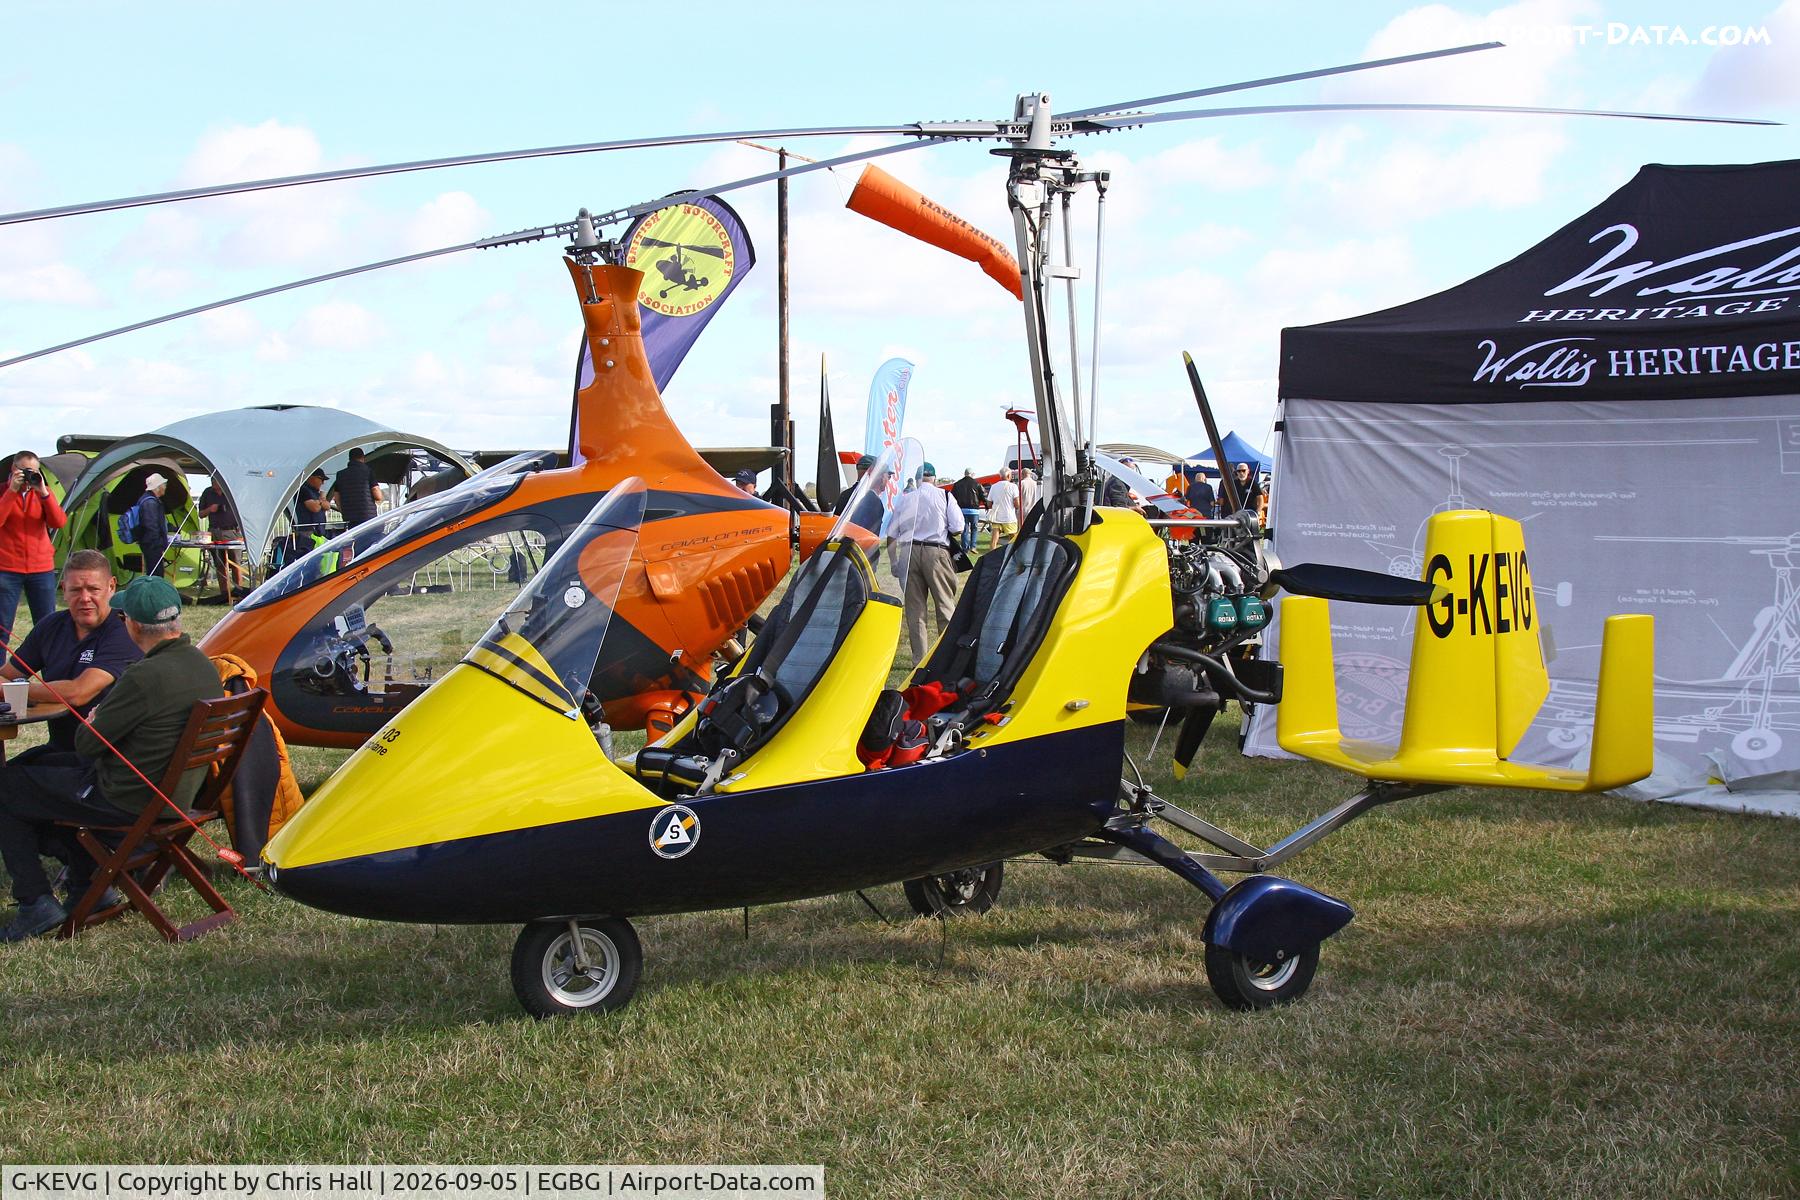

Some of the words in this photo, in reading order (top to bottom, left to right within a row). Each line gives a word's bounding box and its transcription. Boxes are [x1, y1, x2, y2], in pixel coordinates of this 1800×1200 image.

[628, 213, 661, 265] BRITISH
[683, 205, 734, 277] ROTORCRAFT
[638, 291, 713, 315] SSOCIATION
[1516, 297, 1790, 323] HERITAGE
[1473, 337, 1598, 390] Wallis
[1608, 341, 1800, 377] HERITAGE
[1425, 550, 1532, 639] G-KEVG
[1217, 615, 1236, 624] ROTAX
[1246, 614, 1264, 623] ROTAX
[669, 824, 681, 840] S
